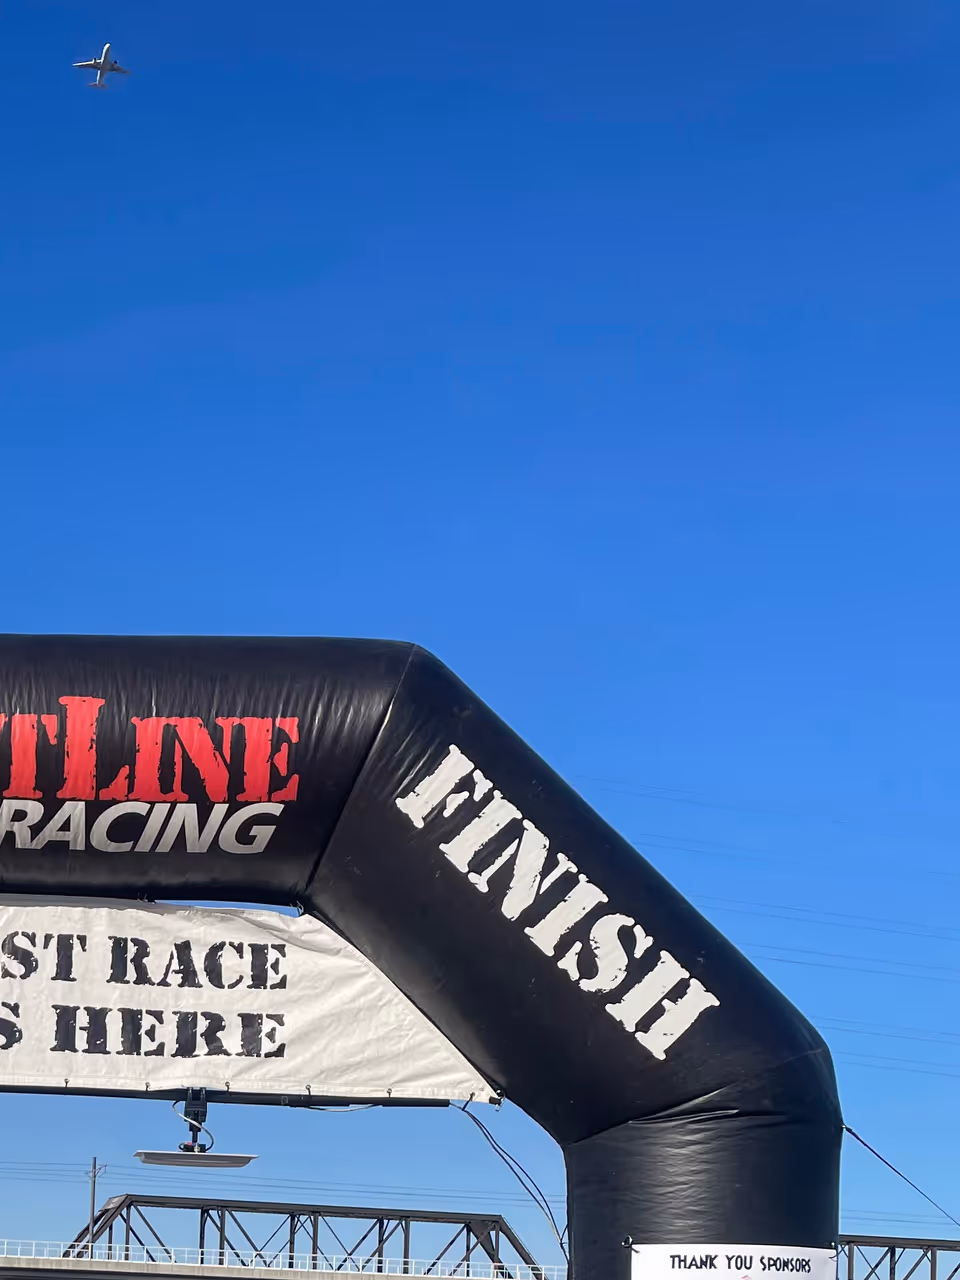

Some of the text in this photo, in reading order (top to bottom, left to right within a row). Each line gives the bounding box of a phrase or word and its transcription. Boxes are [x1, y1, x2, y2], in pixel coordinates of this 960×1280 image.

[395, 744, 721, 1060] FINISH
[106, 935, 288, 990] RACE
[49, 1004, 287, 1059] HERE
[670, 1255, 811, 1273] THANK YOU SPONSORS
